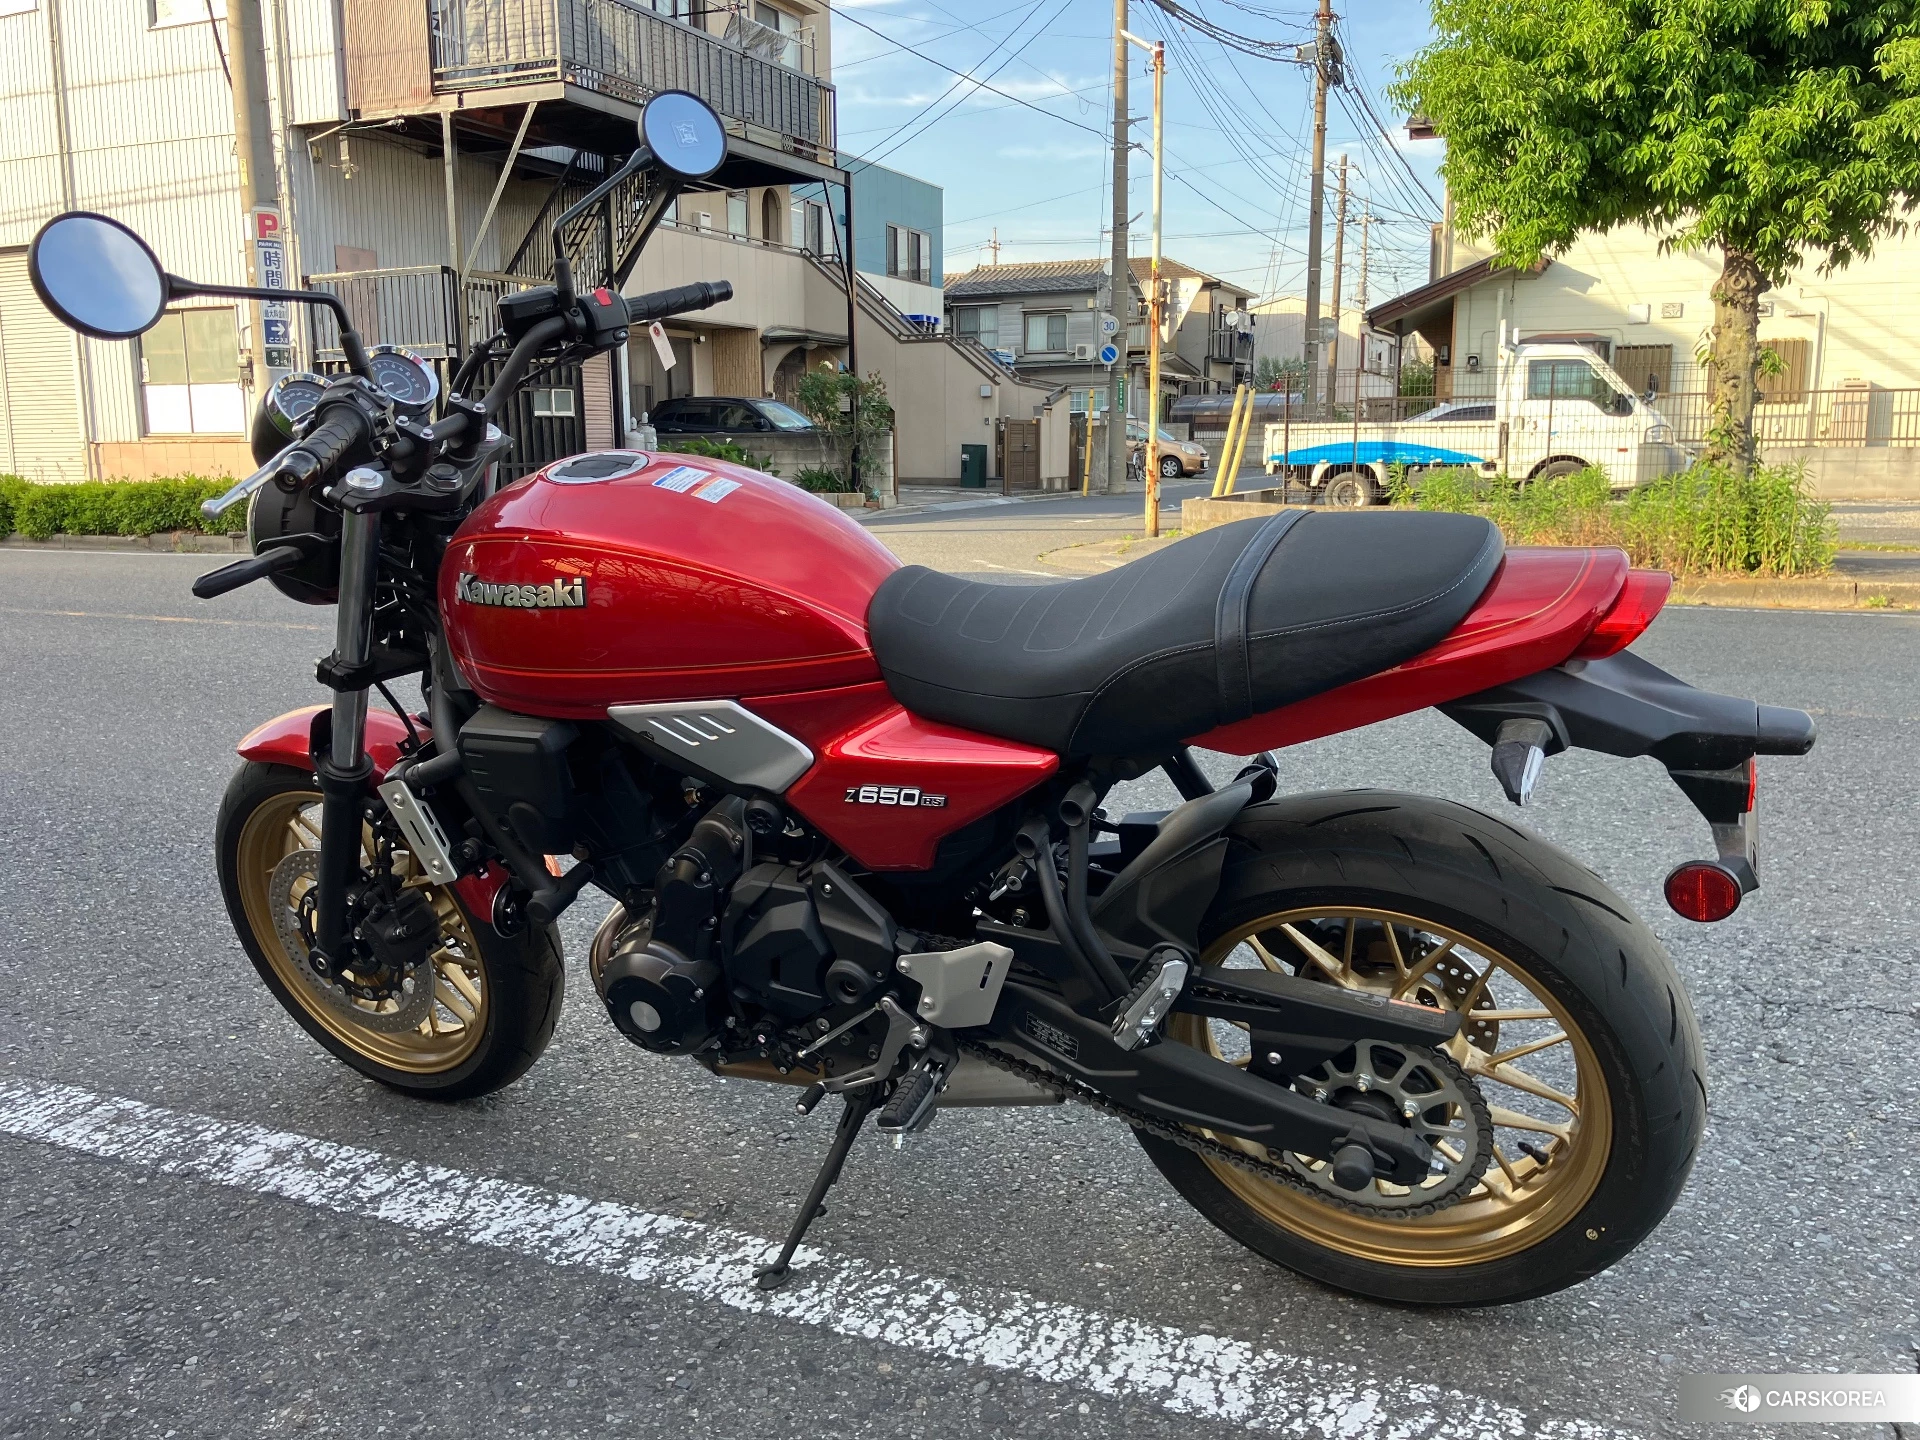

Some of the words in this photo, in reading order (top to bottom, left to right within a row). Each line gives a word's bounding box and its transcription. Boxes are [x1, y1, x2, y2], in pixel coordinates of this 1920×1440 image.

[257, 213, 278, 239] P
[1103, 321, 1116, 331] 30
[457, 571, 585, 608] Kawasaki
